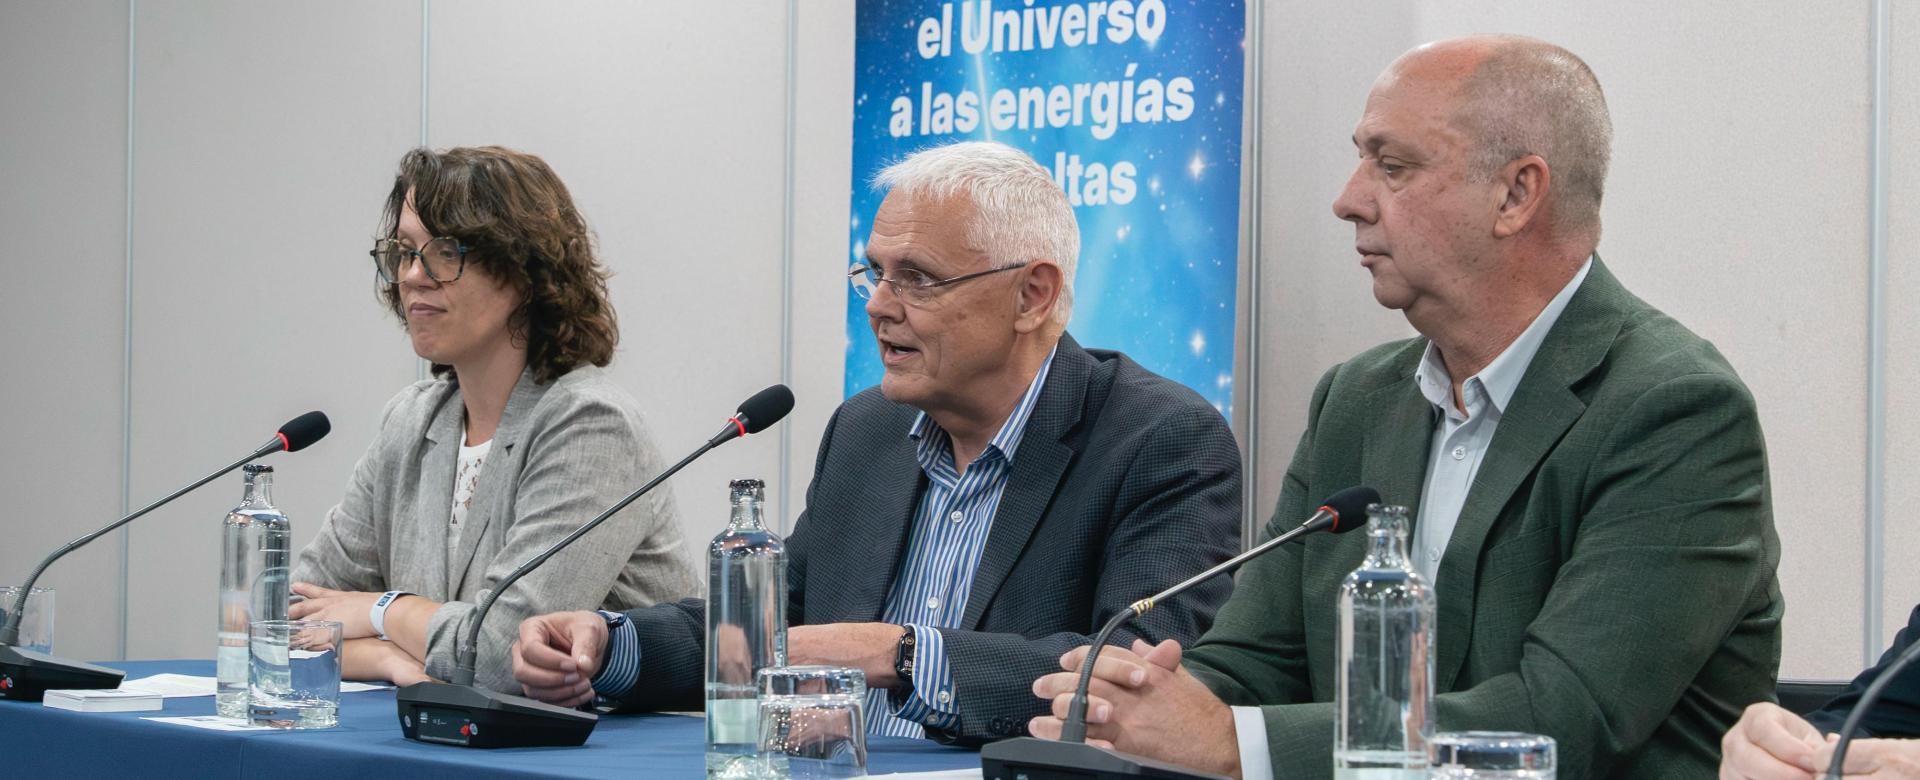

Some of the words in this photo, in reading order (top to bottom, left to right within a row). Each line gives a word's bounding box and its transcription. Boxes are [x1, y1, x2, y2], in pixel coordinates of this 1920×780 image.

[917, 3, 953, 59] el
[961, 0, 1166, 54] Universo
[889, 96, 913, 137] a
[920, 82, 980, 136] las
[990, 63, 1195, 140] energías
[1043, 152, 1137, 207] ltas
